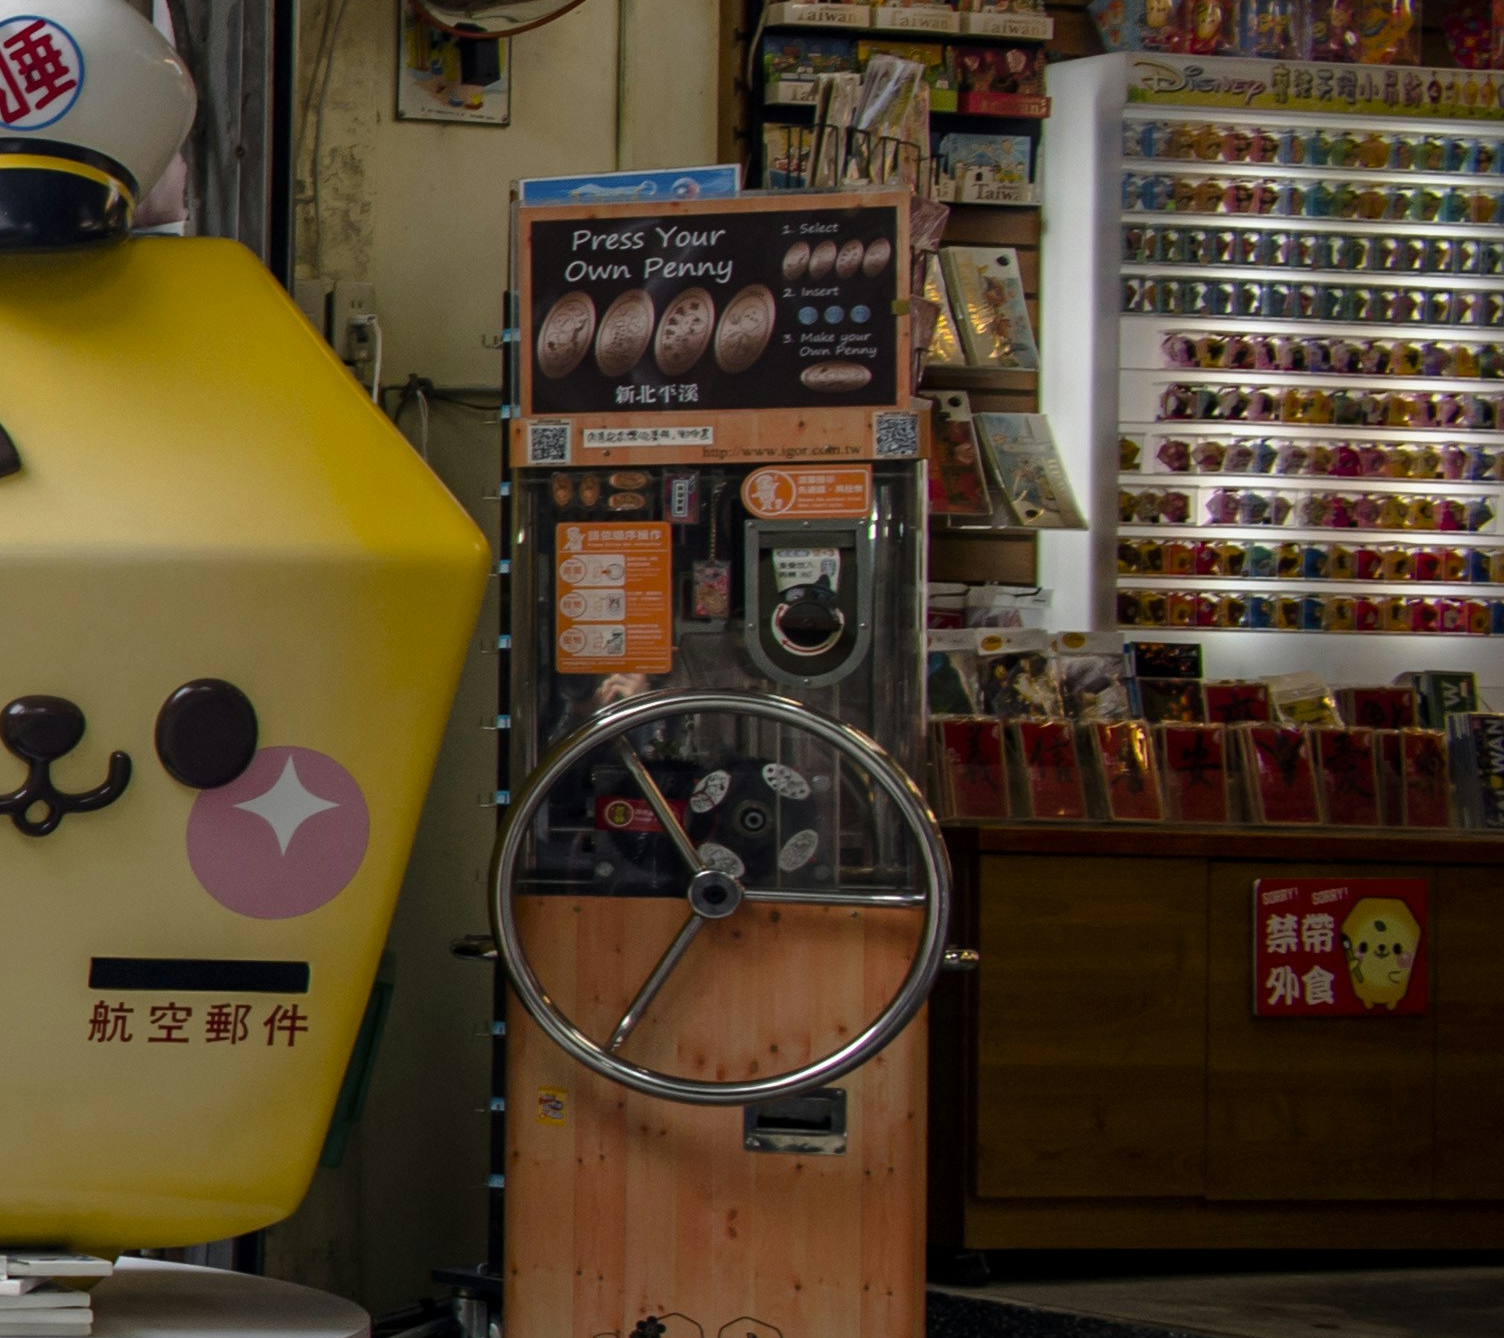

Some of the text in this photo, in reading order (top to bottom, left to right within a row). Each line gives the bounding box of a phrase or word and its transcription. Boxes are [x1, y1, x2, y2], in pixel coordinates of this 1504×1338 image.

[1136, 62, 1266, 105] Disney
[571, 225, 727, 254] Press Your
[798, 221, 840, 235] Select
[563, 257, 734, 285] Own Penny
[800, 284, 841, 298] Insert
[798, 344, 878, 359] Own Penny
[799, 330, 836, 345] Make
[839, 330, 873, 346] your
[614, 382, 700, 405] 新北平溪
[1265, 912, 1335, 954] 禁帶
[1265, 964, 1335, 1006] 外食
[87, 999, 310, 1048] 航空郵件
